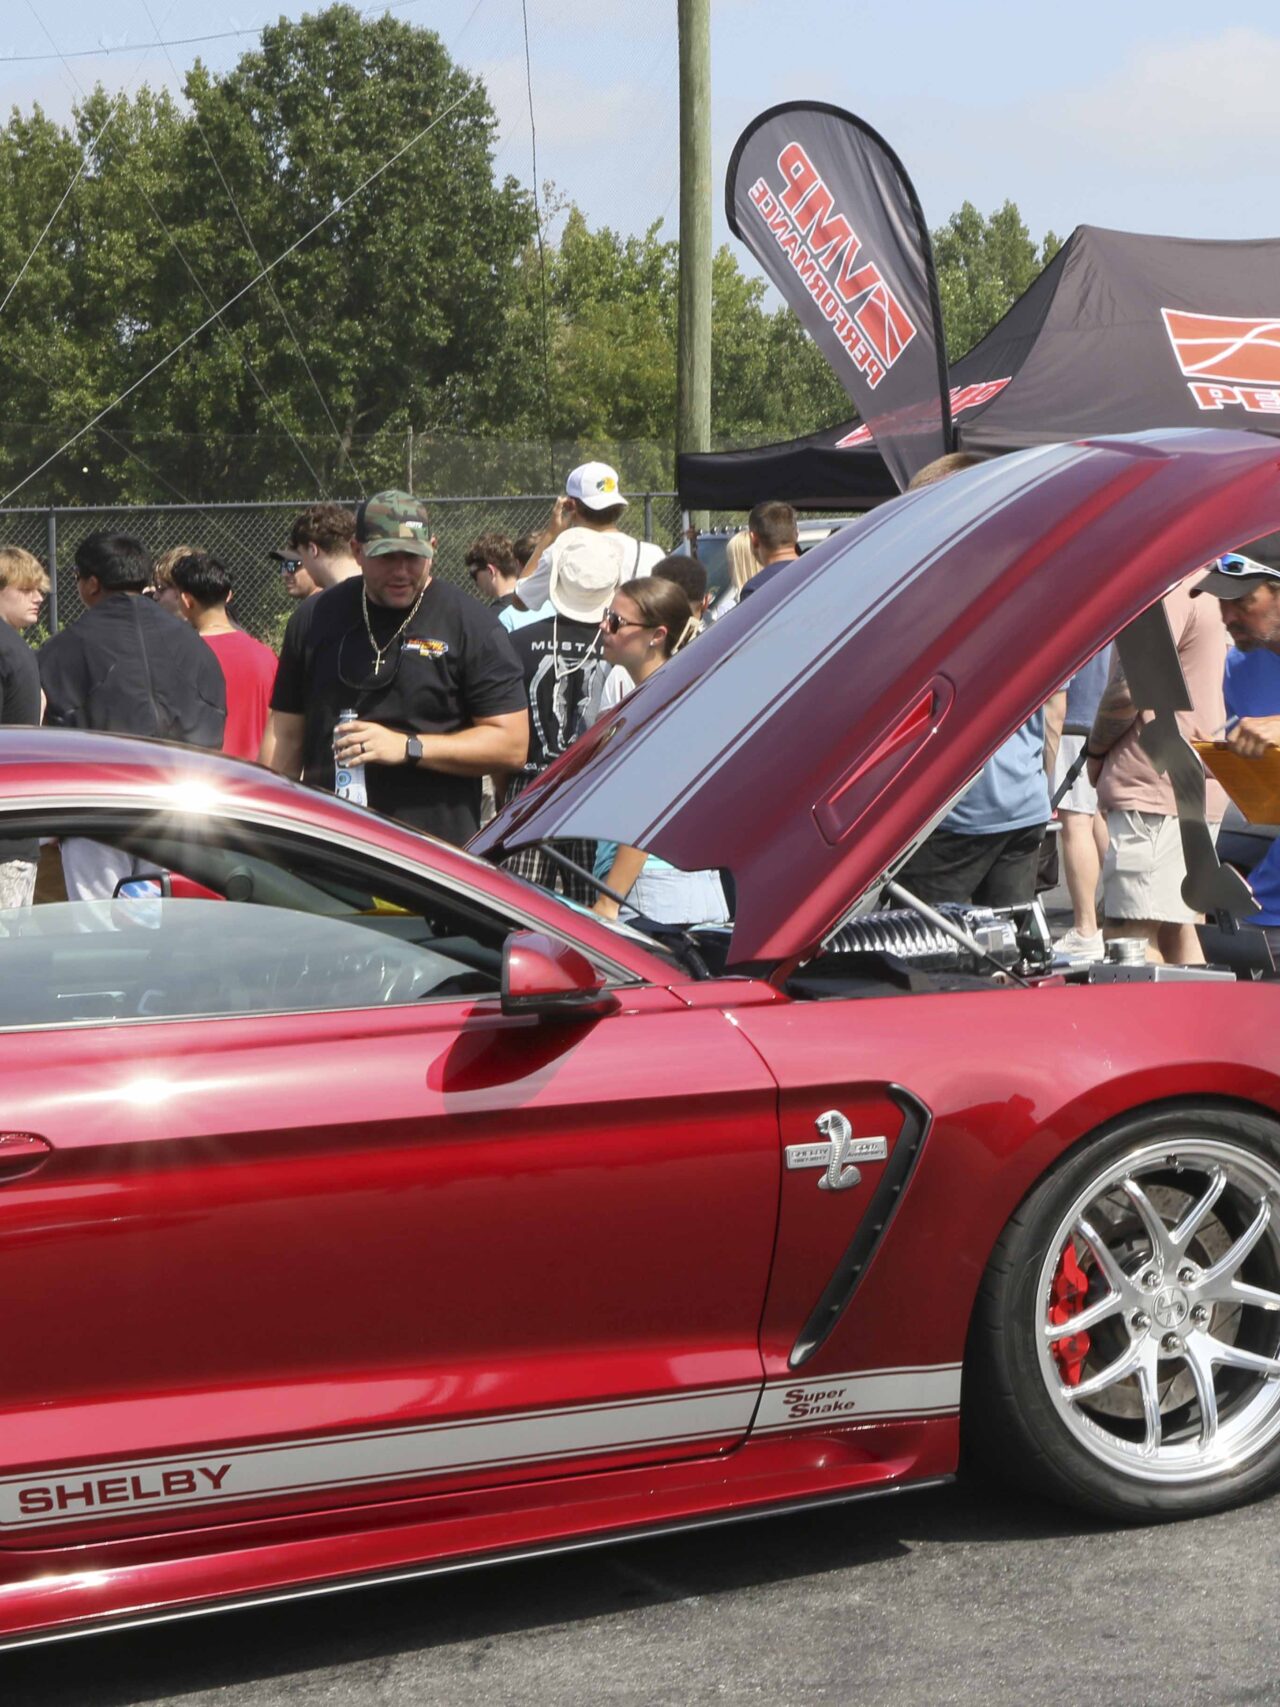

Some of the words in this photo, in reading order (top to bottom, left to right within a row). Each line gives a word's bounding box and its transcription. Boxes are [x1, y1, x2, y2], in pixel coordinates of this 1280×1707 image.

[783, 1389, 847, 1405] Super
[788, 1400, 855, 1418] Snake
[18, 1464, 232, 1515] SHELBY
